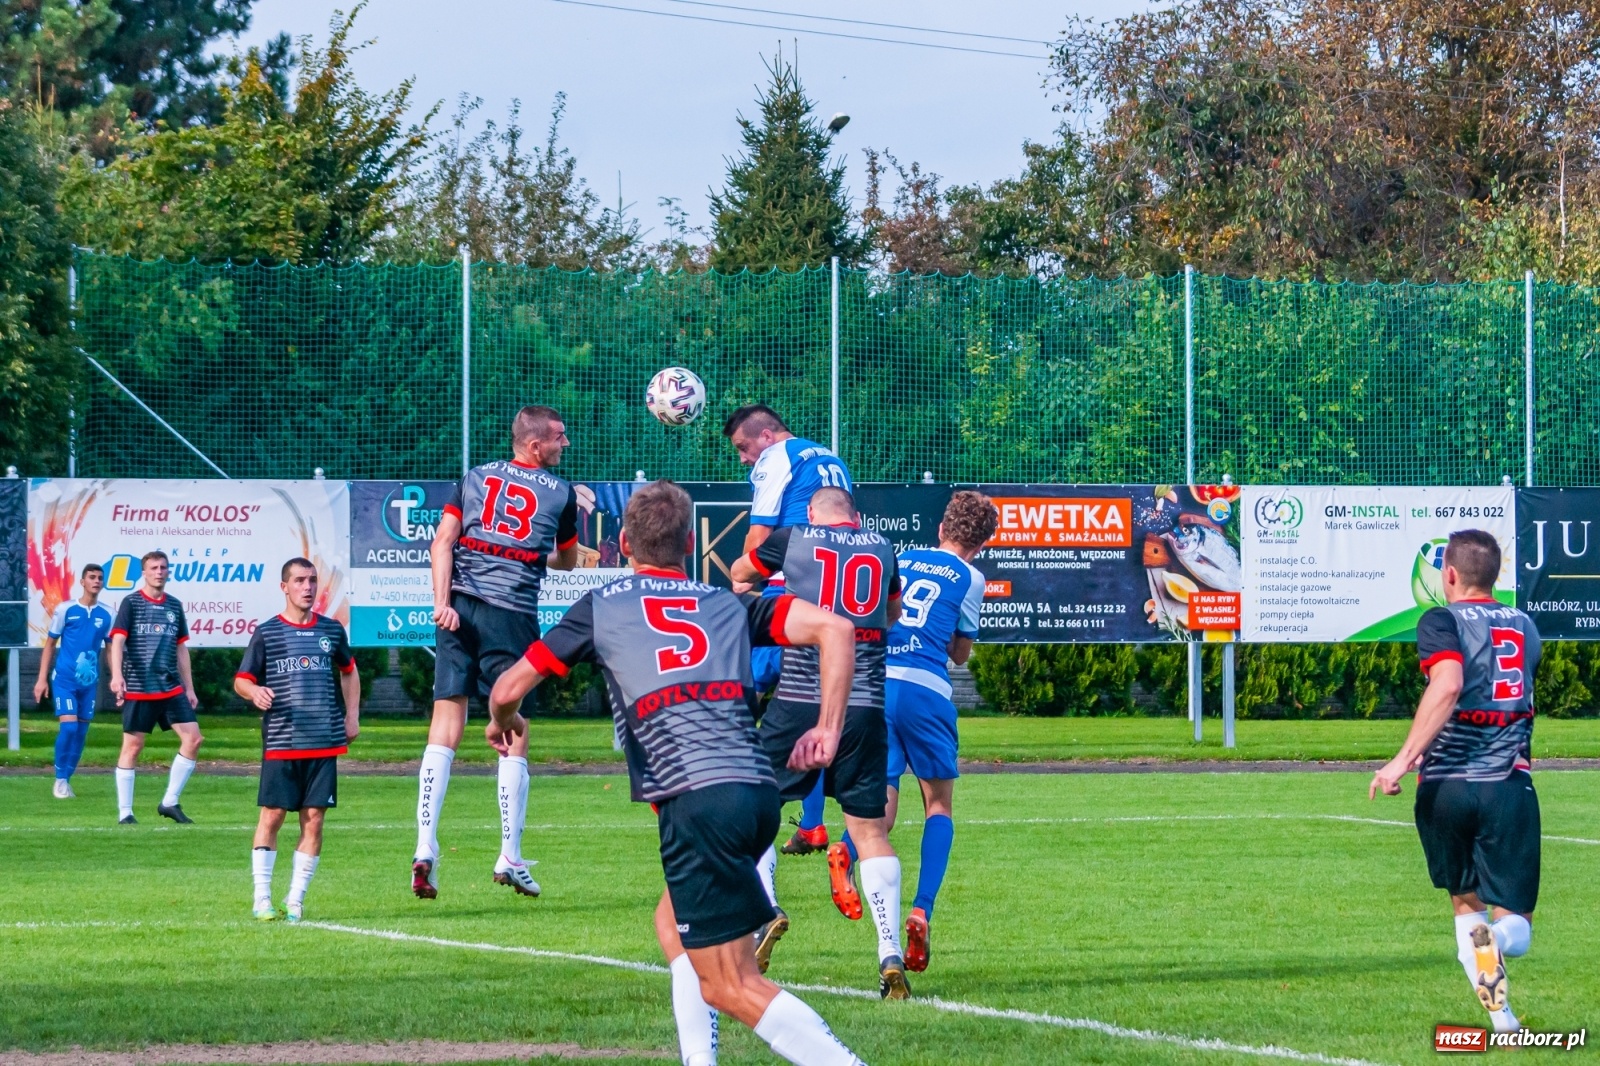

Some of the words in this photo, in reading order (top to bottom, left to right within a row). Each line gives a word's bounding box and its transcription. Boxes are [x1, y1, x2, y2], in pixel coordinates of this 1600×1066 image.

[112, 504, 169, 522] Firma
[481, 475, 539, 541] 13
[1324, 505, 1400, 518] GM-INSTAL
[1411, 507, 1432, 518] tel.
[1435, 507, 1456, 518] 667
[1459, 507, 1480, 518] 843
[1483, 507, 1504, 518] 022
[912, 514, 920, 531] 5
[1324, 521, 1353, 530] Marek
[1355, 520, 1400, 530] Gawliczek
[120, 527, 153, 536] Helena
[156, 527, 159, 536] i
[162, 527, 214, 536] Aleksander
[217, 527, 252, 536] Michna
[803, 527, 826, 538] LKS
[1000, 532, 1038, 542] RYBNY
[1044, 532, 1052, 542] &
[1059, 530, 1125, 542] SMAŻALNIA
[1257, 529, 1300, 538] GM-INSTAL
[366, 549, 433, 563] AGENCJA
[989, 548, 1026, 562] ŚWIEŻE,
[1028, 548, 1078, 561] MROŻONE,
[1081, 550, 1126, 562] WĘDZONE
[1260, 557, 1298, 566] instalacje
[911, 562, 961, 584] RACIBÓRZ
[1260, 570, 1298, 580] instalacje
[1301, 570, 1386, 580] wodno-kanalizacyjne
[370, 575, 421, 587] Wyzwolenia
[423, 575, 428, 585] 2
[813, 546, 883, 617] 10
[603, 579, 633, 597] LKS
[1260, 584, 1298, 593] instalacje
[370, 592, 400, 601] 47-450
[1260, 597, 1298, 607] instalacje
[1300, 597, 1360, 605] fotowoltaiczne
[980, 603, 1033, 613] ZBOROWA
[1037, 603, 1051, 613] 5A
[1059, 604, 1073, 613] tel.
[1075, 605, 1085, 613] 32
[1087, 605, 1102, 613] 415
[1104, 605, 1114, 613] 22
[1116, 605, 1126, 613] 32
[1527, 599, 1583, 613] RACIBÓRZ,
[1260, 612, 1288, 620] pompy
[1290, 611, 1314, 620] ciepła
[980, 617, 1020, 628] OCICKA
[1023, 617, 1030, 627] 5
[1038, 619, 1052, 628] tel.
[1054, 620, 1064, 628] 32
[1066, 620, 1081, 628] 666
[1083, 620, 1088, 628] 0
[1091, 620, 1105, 628] 111
[1260, 624, 1308, 634] rekuperacja
[641, 596, 710, 675] 5
[1489, 626, 1524, 700] 3
